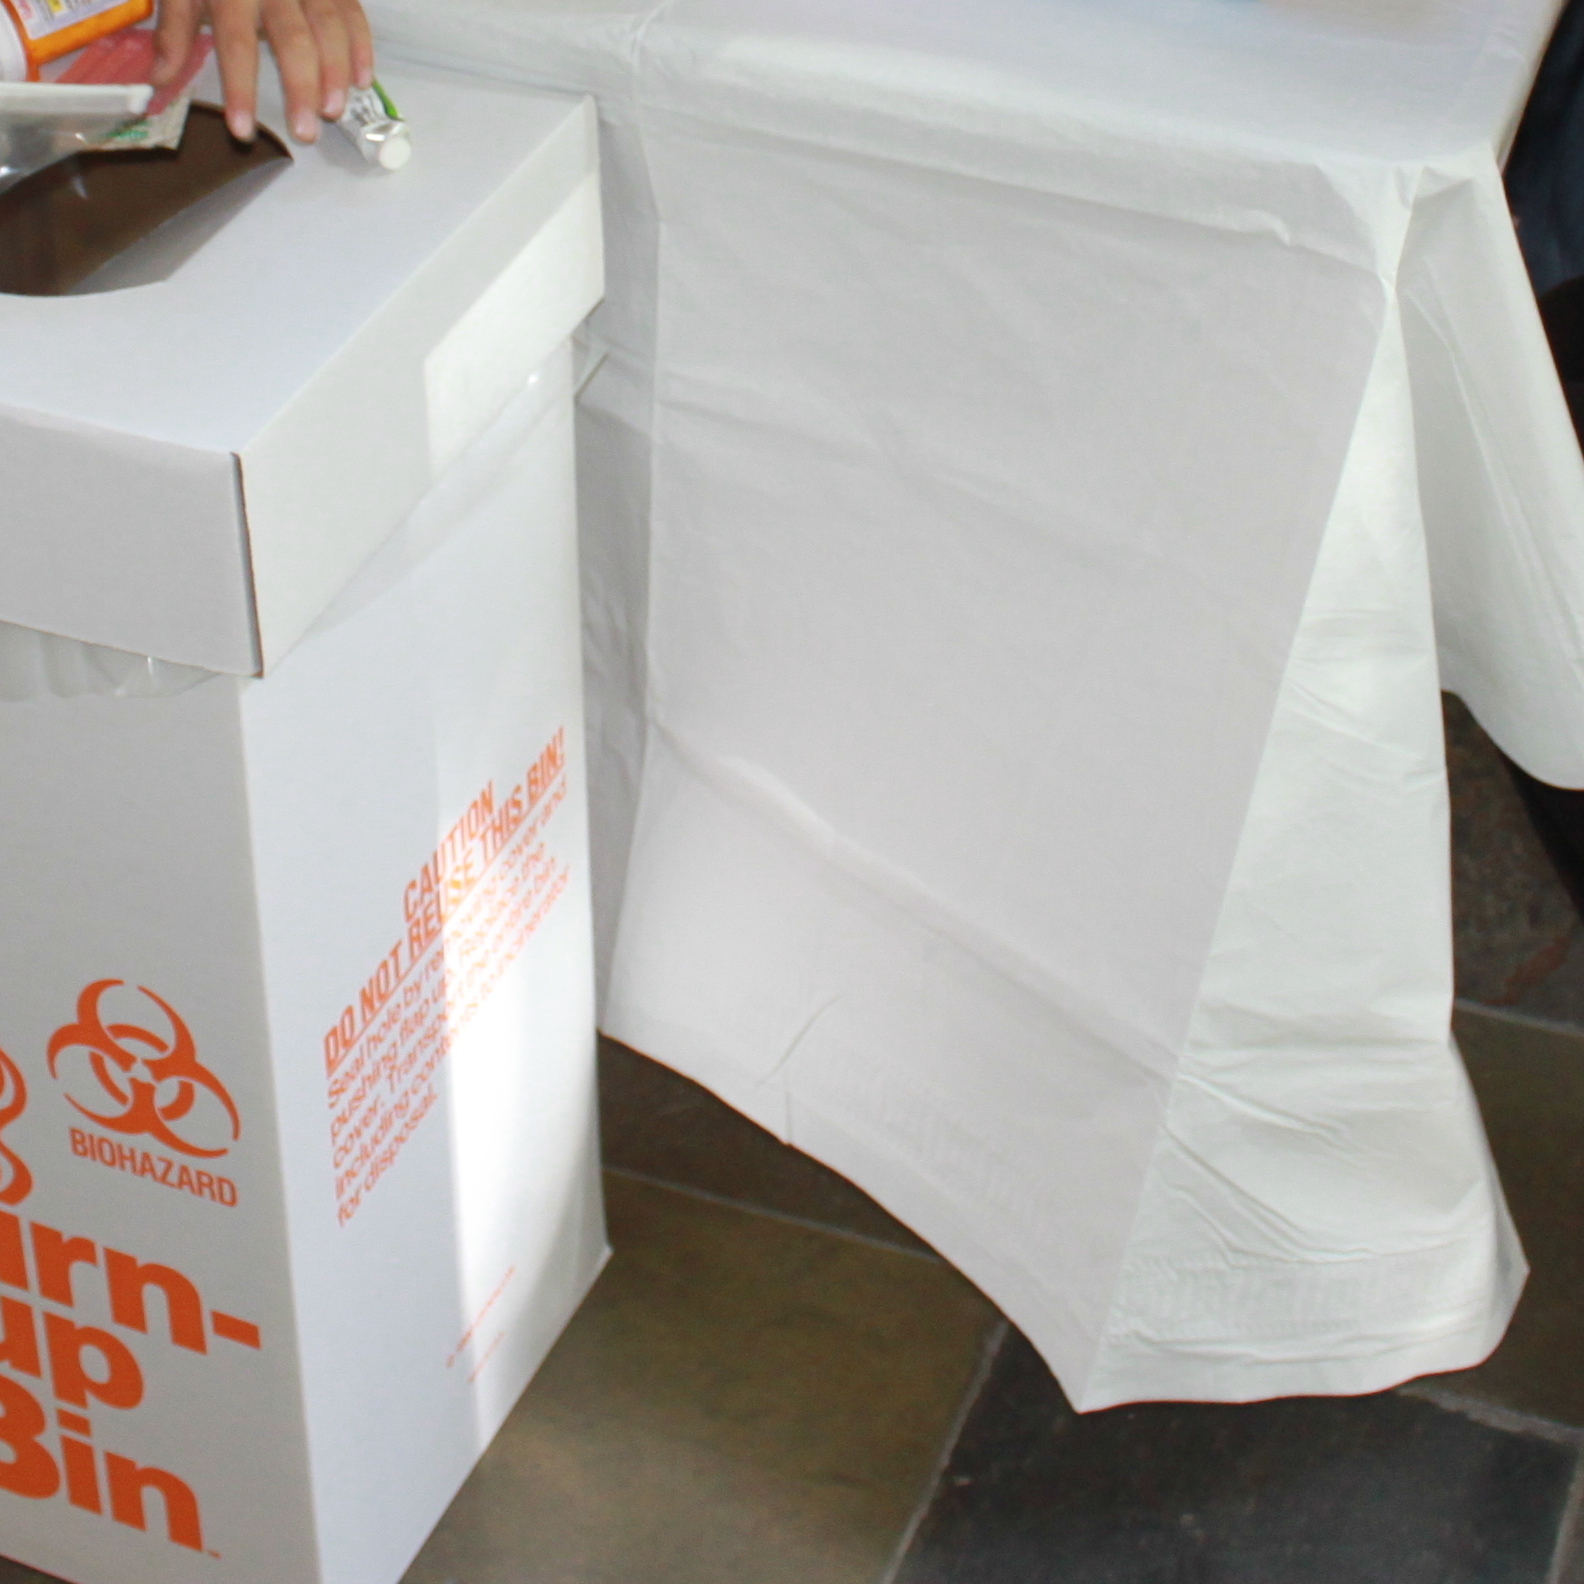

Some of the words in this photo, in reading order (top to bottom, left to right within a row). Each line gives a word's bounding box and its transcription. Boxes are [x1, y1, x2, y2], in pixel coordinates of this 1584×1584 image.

[324, 1004, 355, 1074] DO
[360, 939, 402, 1025] NOT
[408, 848, 476, 964] REUSE
[480, 784, 523, 866] THIS
[527, 725, 566, 806] BIN!
[403, 779, 493, 923] CAUTION
[69, 1127, 238, 1207] BIOHAZARD
